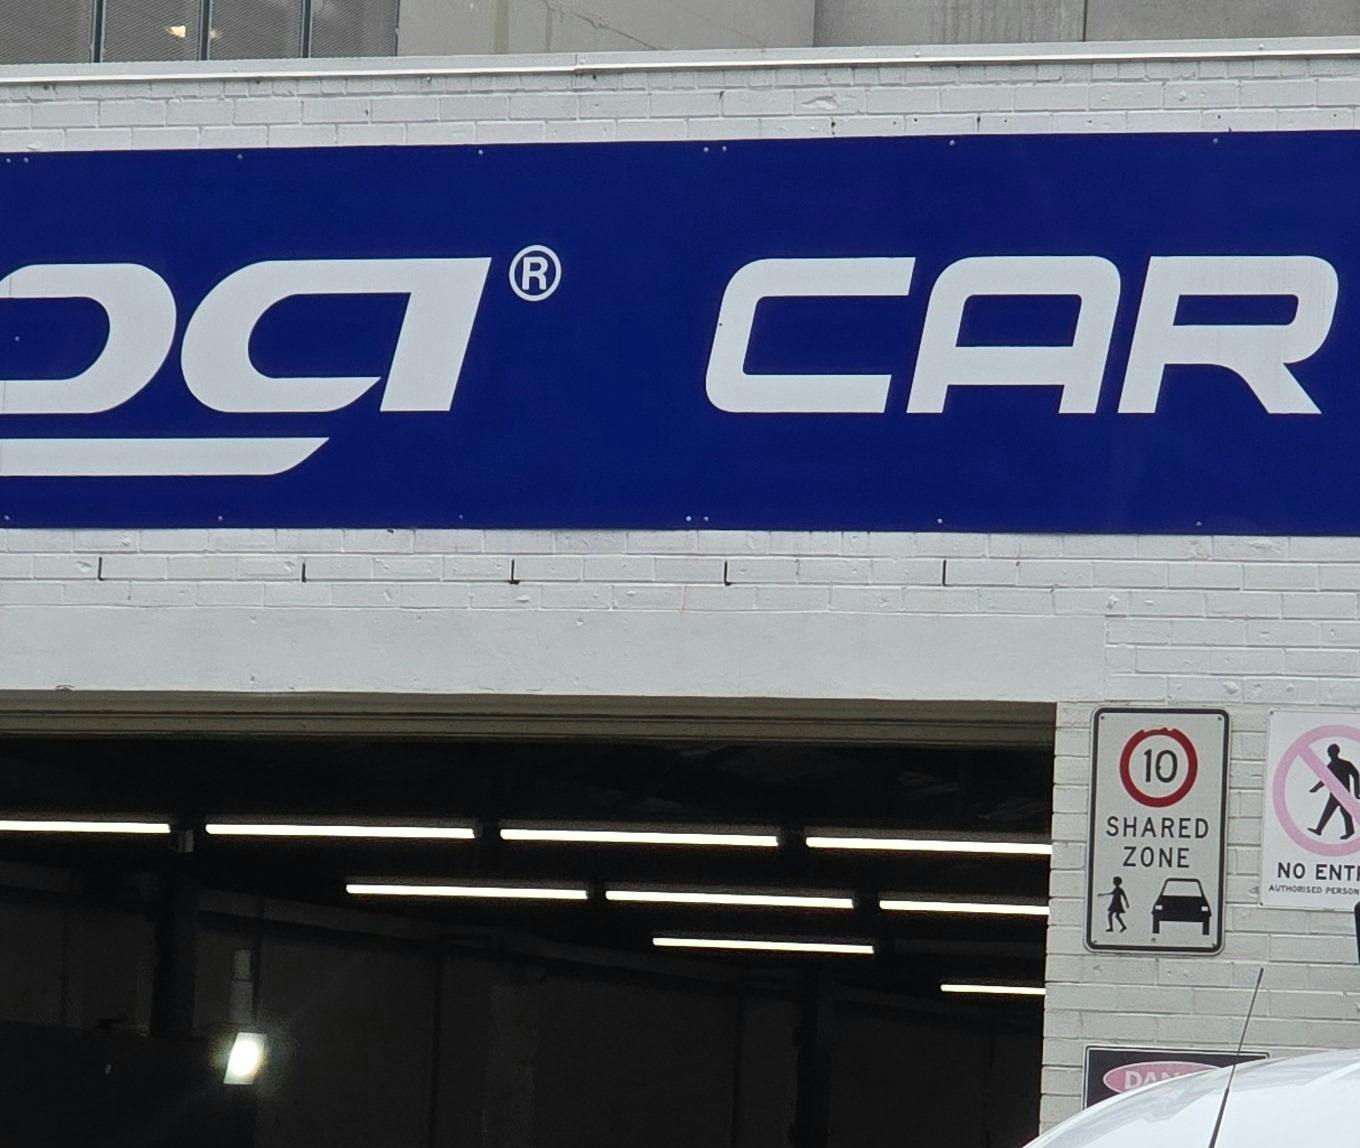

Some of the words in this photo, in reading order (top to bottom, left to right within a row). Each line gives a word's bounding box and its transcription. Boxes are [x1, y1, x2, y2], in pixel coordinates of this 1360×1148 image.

[705, 254, 1340, 415] CAR
[1143, 749, 1178, 783] 10
[1106, 816, 1209, 839] SHARED
[1122, 846, 1190, 868] ZONE
[1277, 862, 1305, 879] NO
[1268, 884, 1322, 894] AUTHORISED
